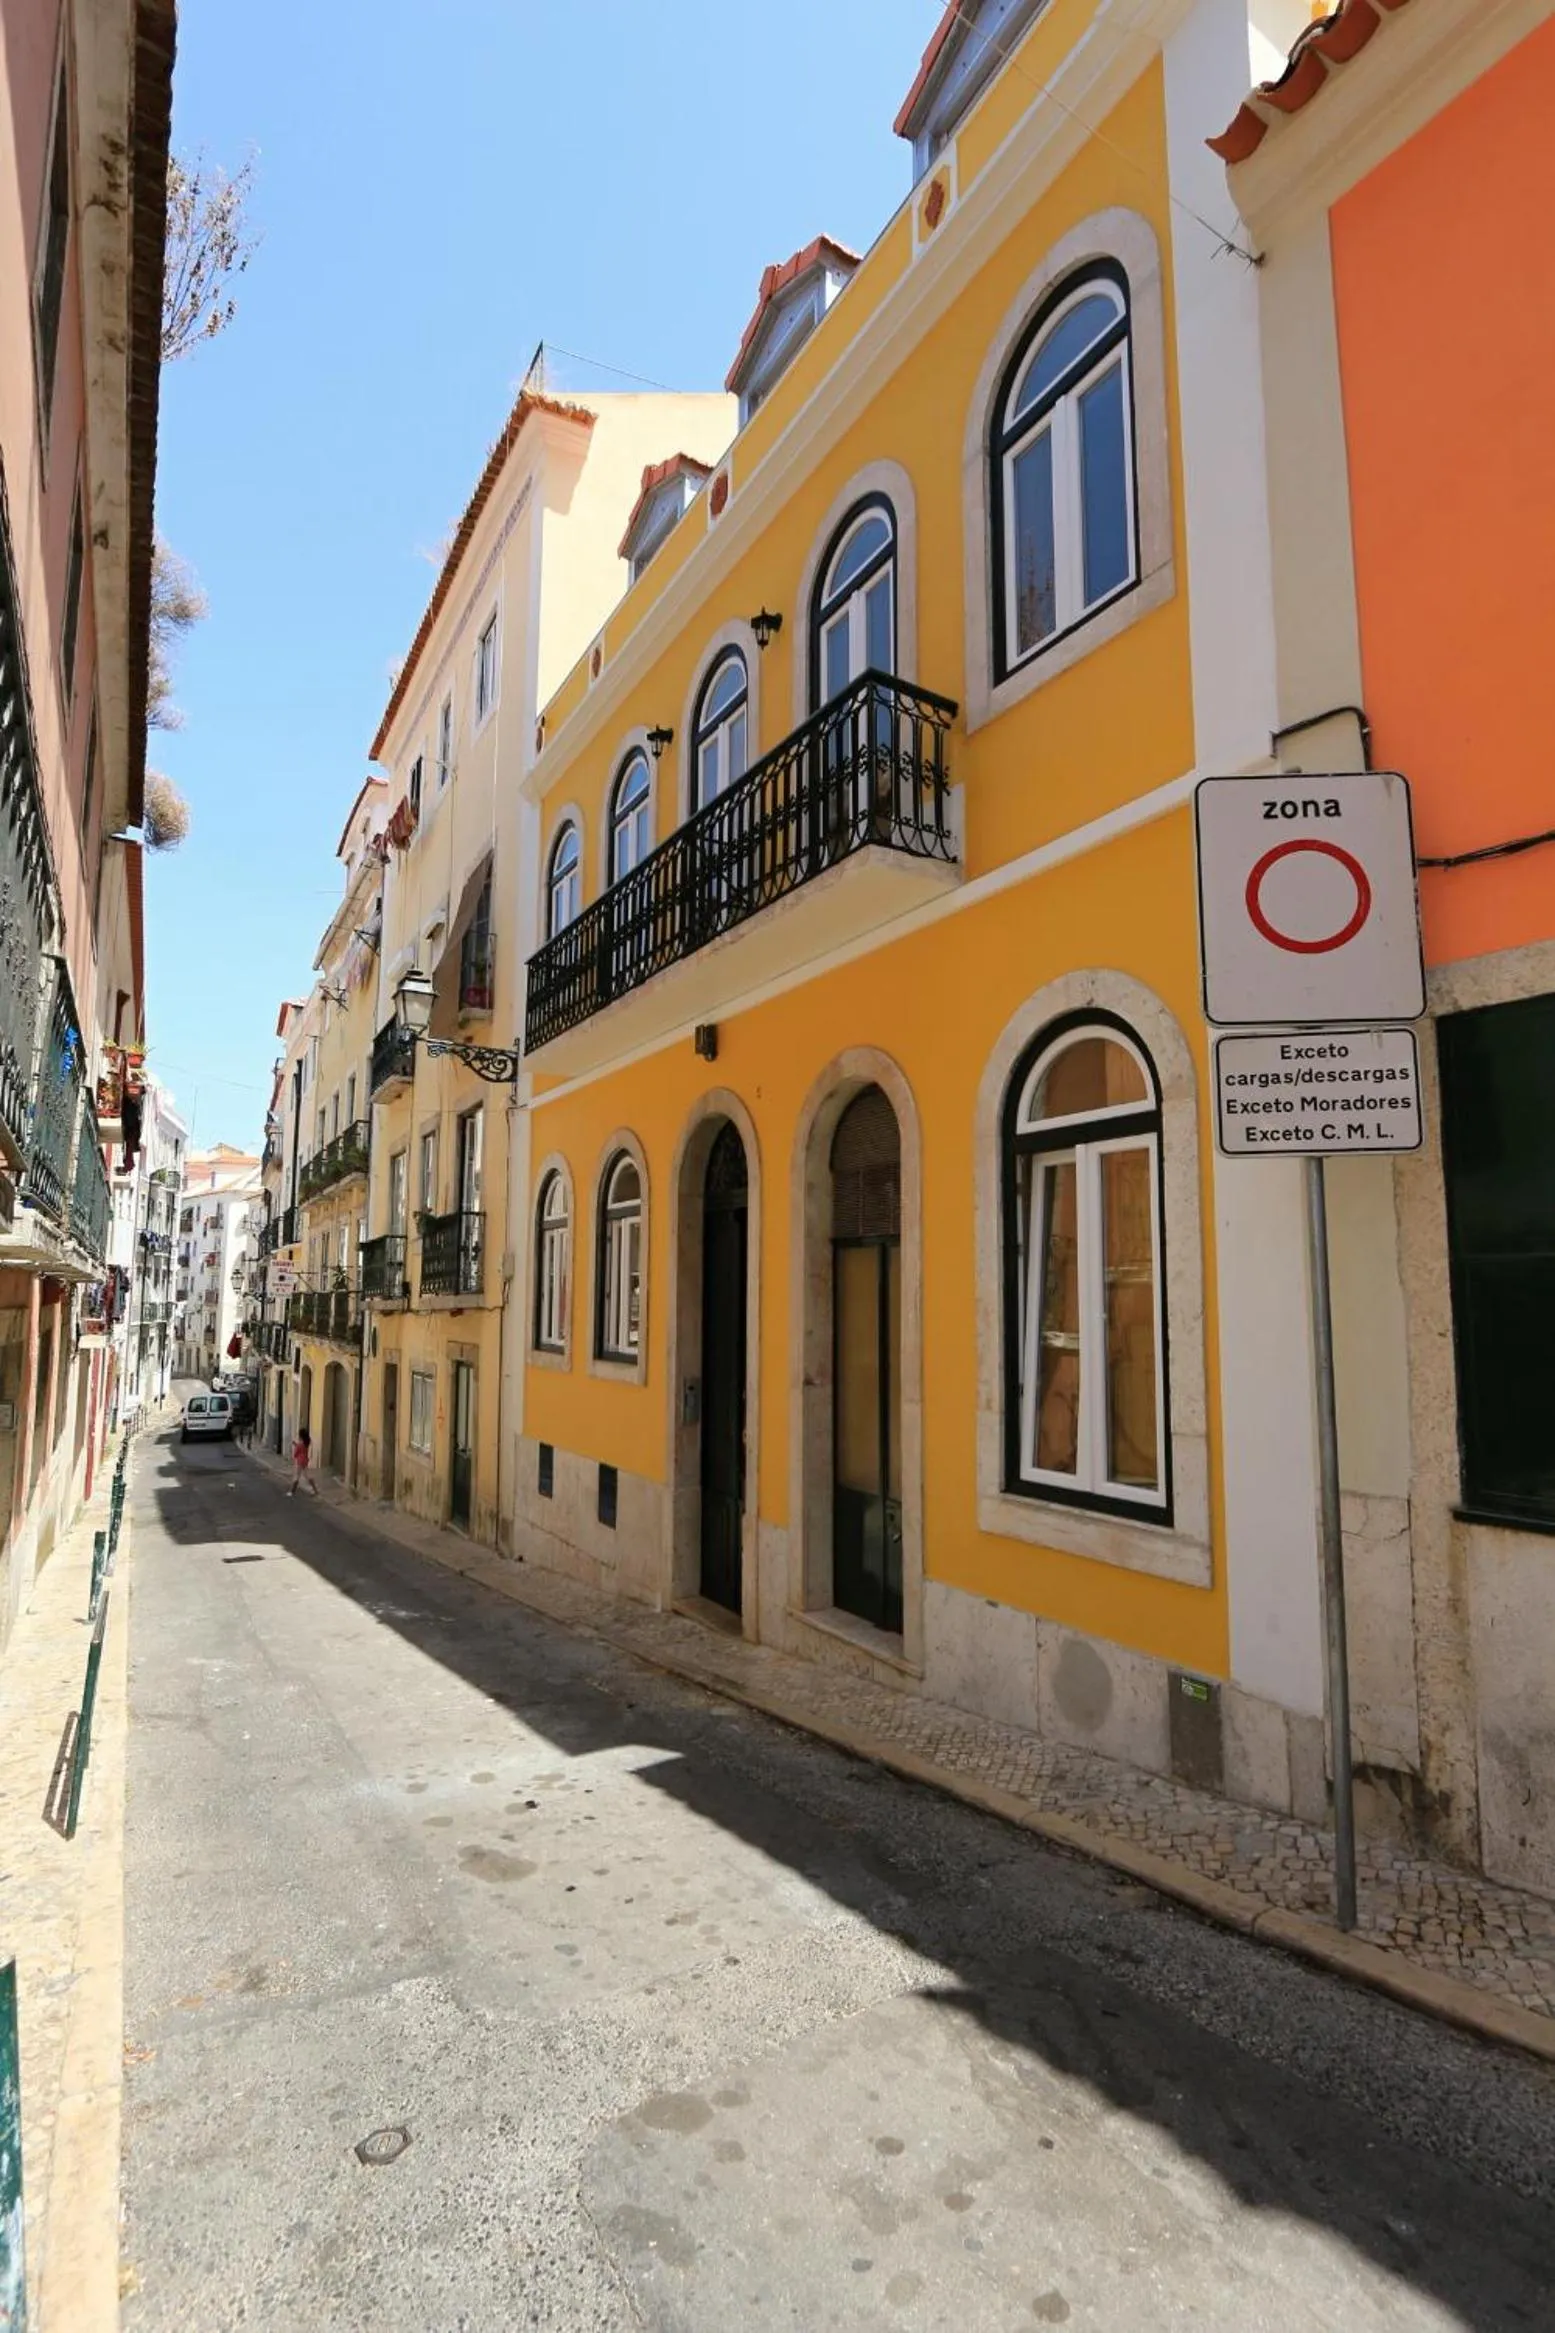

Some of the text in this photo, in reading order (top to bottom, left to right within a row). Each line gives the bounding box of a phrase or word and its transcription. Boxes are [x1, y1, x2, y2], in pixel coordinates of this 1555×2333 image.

[1263, 799, 1341, 819] zona
[1280, 1044, 1349, 1060] Exceto
[1225, 1067, 1410, 1088] cargas/descargas
[1226, 1095, 1411, 1114] Exceto Moradores
[1245, 1126, 1314, 1142] Exceto
